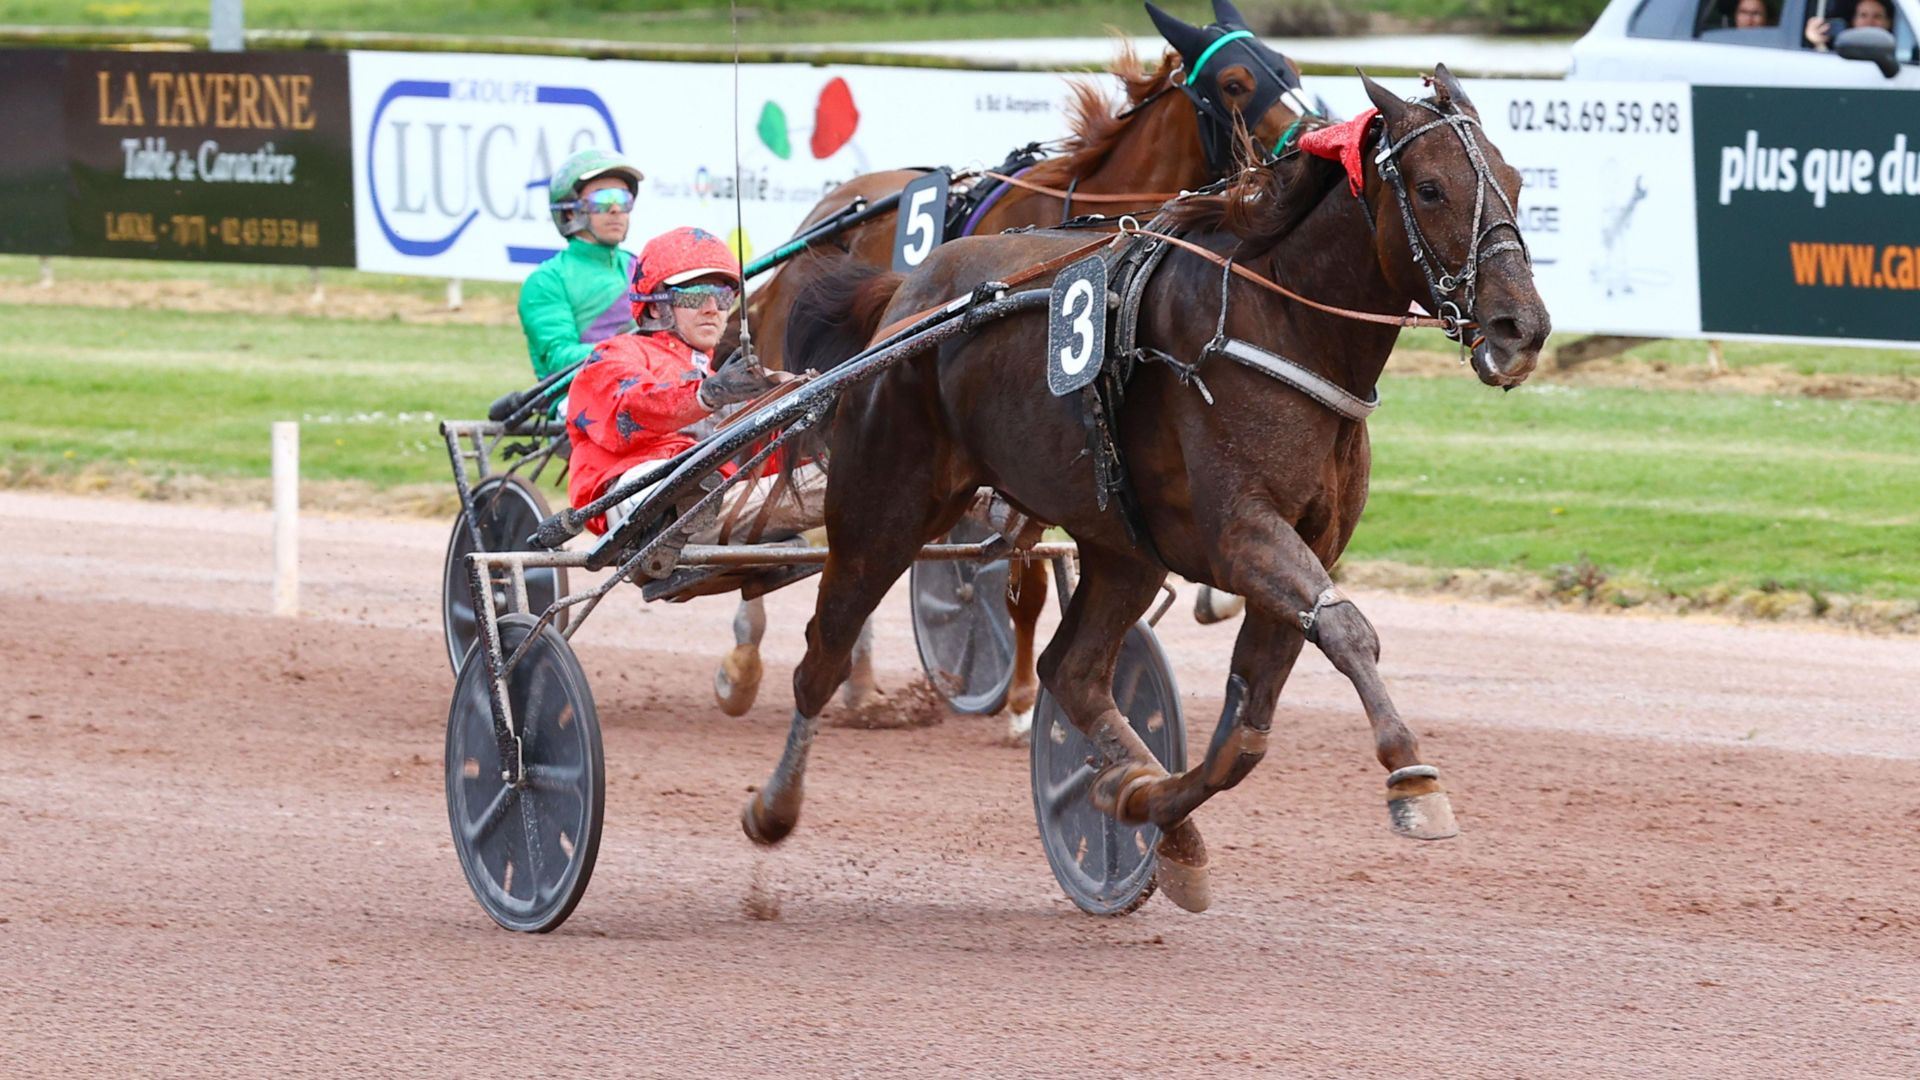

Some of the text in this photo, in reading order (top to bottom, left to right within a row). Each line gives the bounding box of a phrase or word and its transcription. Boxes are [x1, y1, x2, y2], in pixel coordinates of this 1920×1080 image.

[97, 71, 317, 130] LA TAVERNE
[1509, 101, 1680, 134] 02.43.69.59.98
[121, 137, 174, 180] Table
[198, 141, 296, 184] Caractère
[389, 120, 597, 222] LUCA
[1719, 129, 1798, 205] plus
[1802, 148, 1875, 208] que
[903, 186, 938, 266] 5
[1061, 279, 1094, 375] 3
